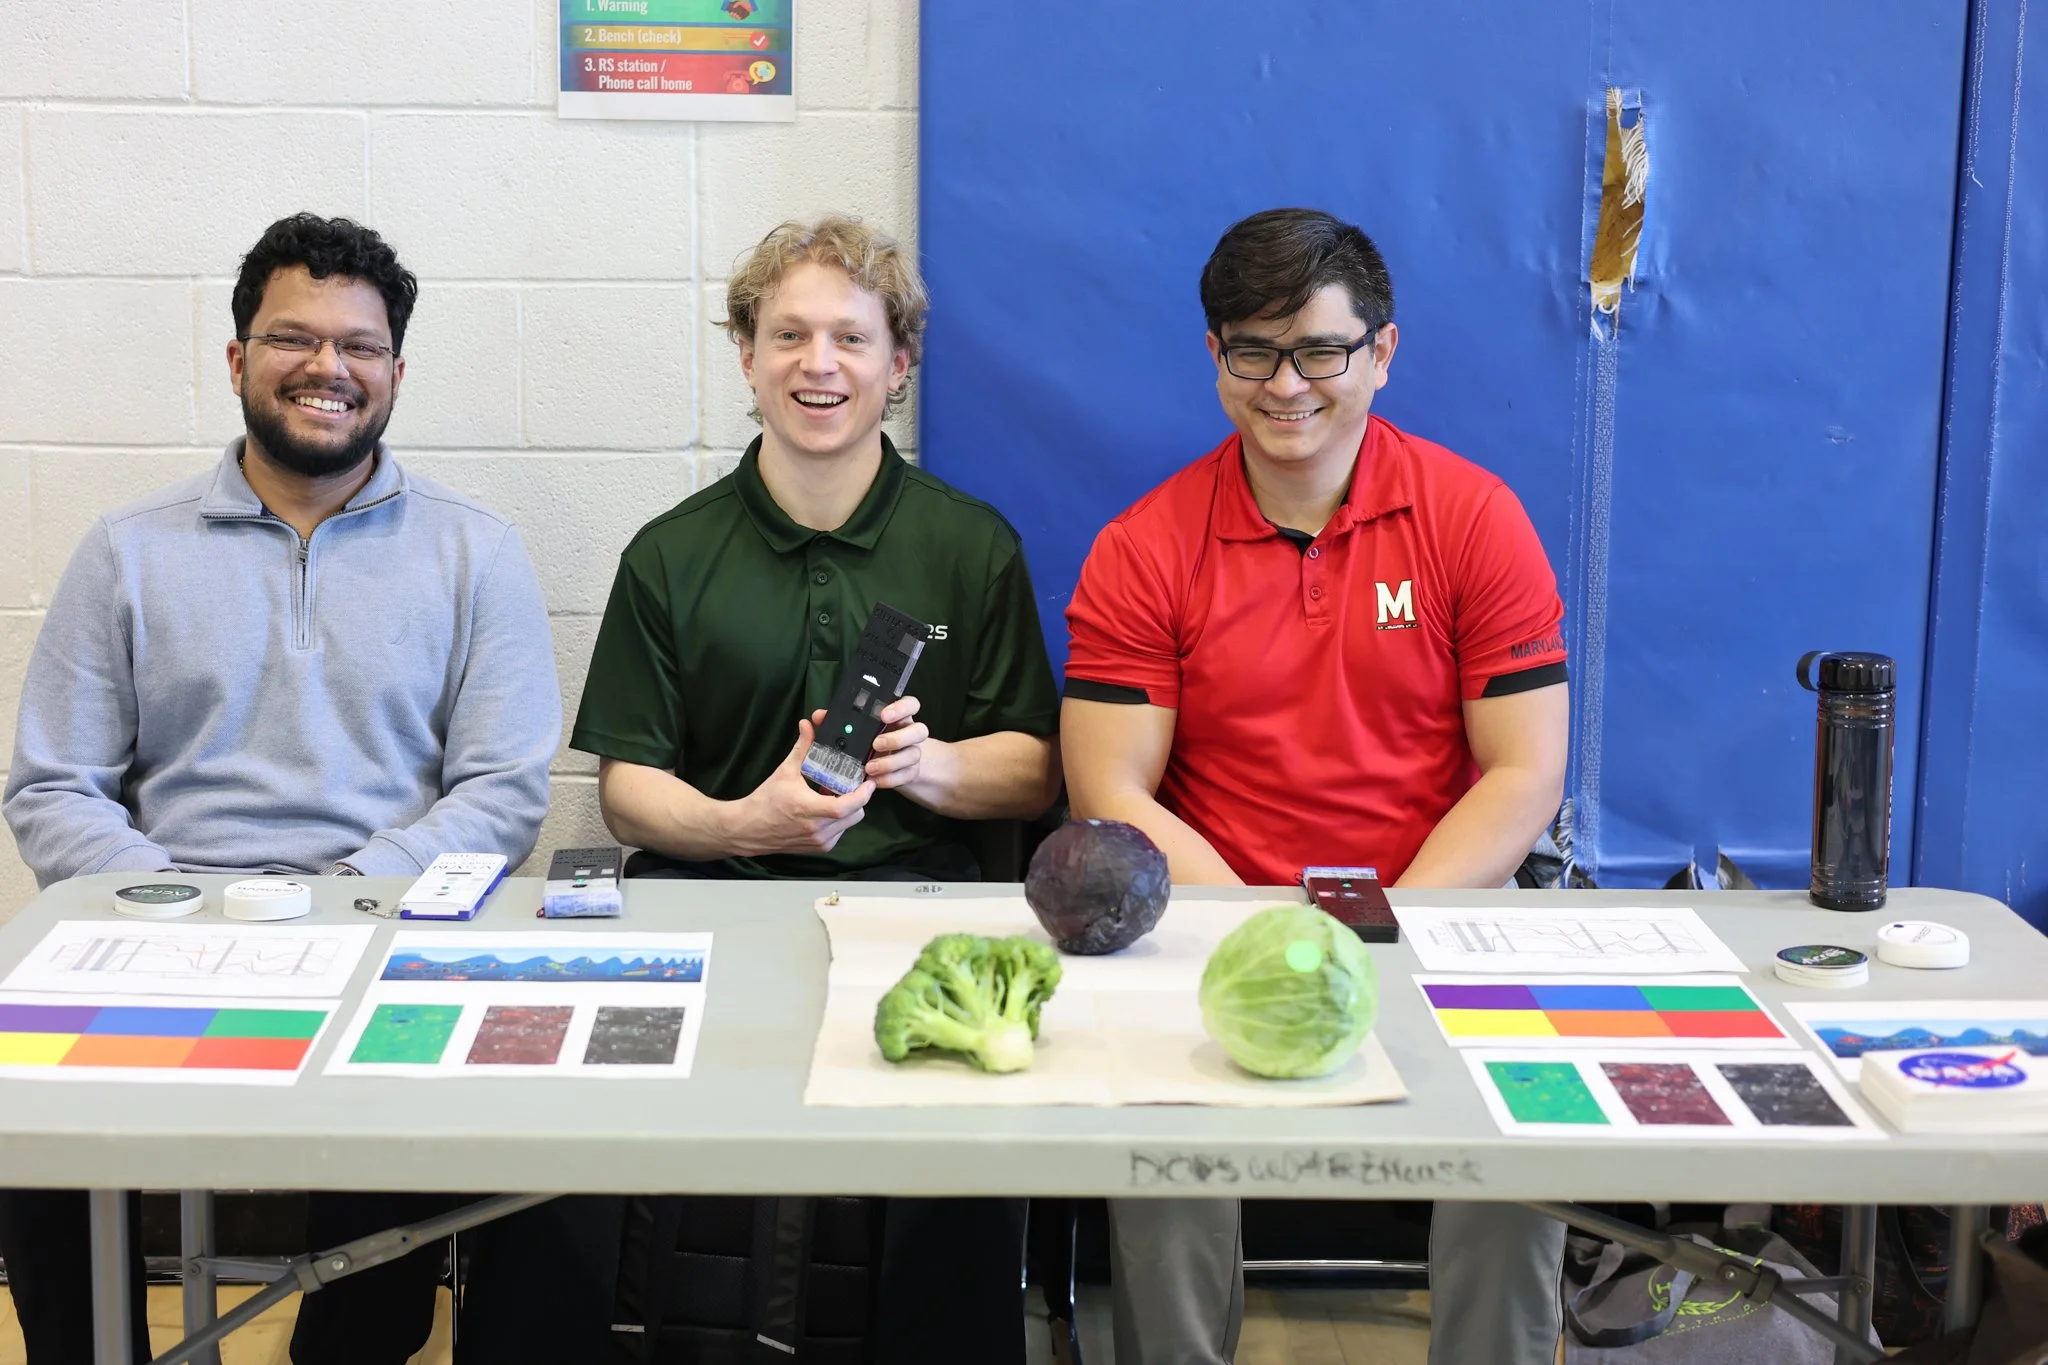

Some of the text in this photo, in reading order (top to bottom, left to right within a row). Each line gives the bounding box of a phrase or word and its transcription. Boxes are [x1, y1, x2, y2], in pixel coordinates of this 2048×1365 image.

[598, 0, 648, 15] Warning
[585, 28, 682, 44] 2. Bench (check)
[585, 58, 596, 72] 3.
[599, 58, 614, 72] RS
[617, 58, 658, 73] station
[599, 75, 693, 90] Phone call home
[1375, 579, 1416, 624] M
